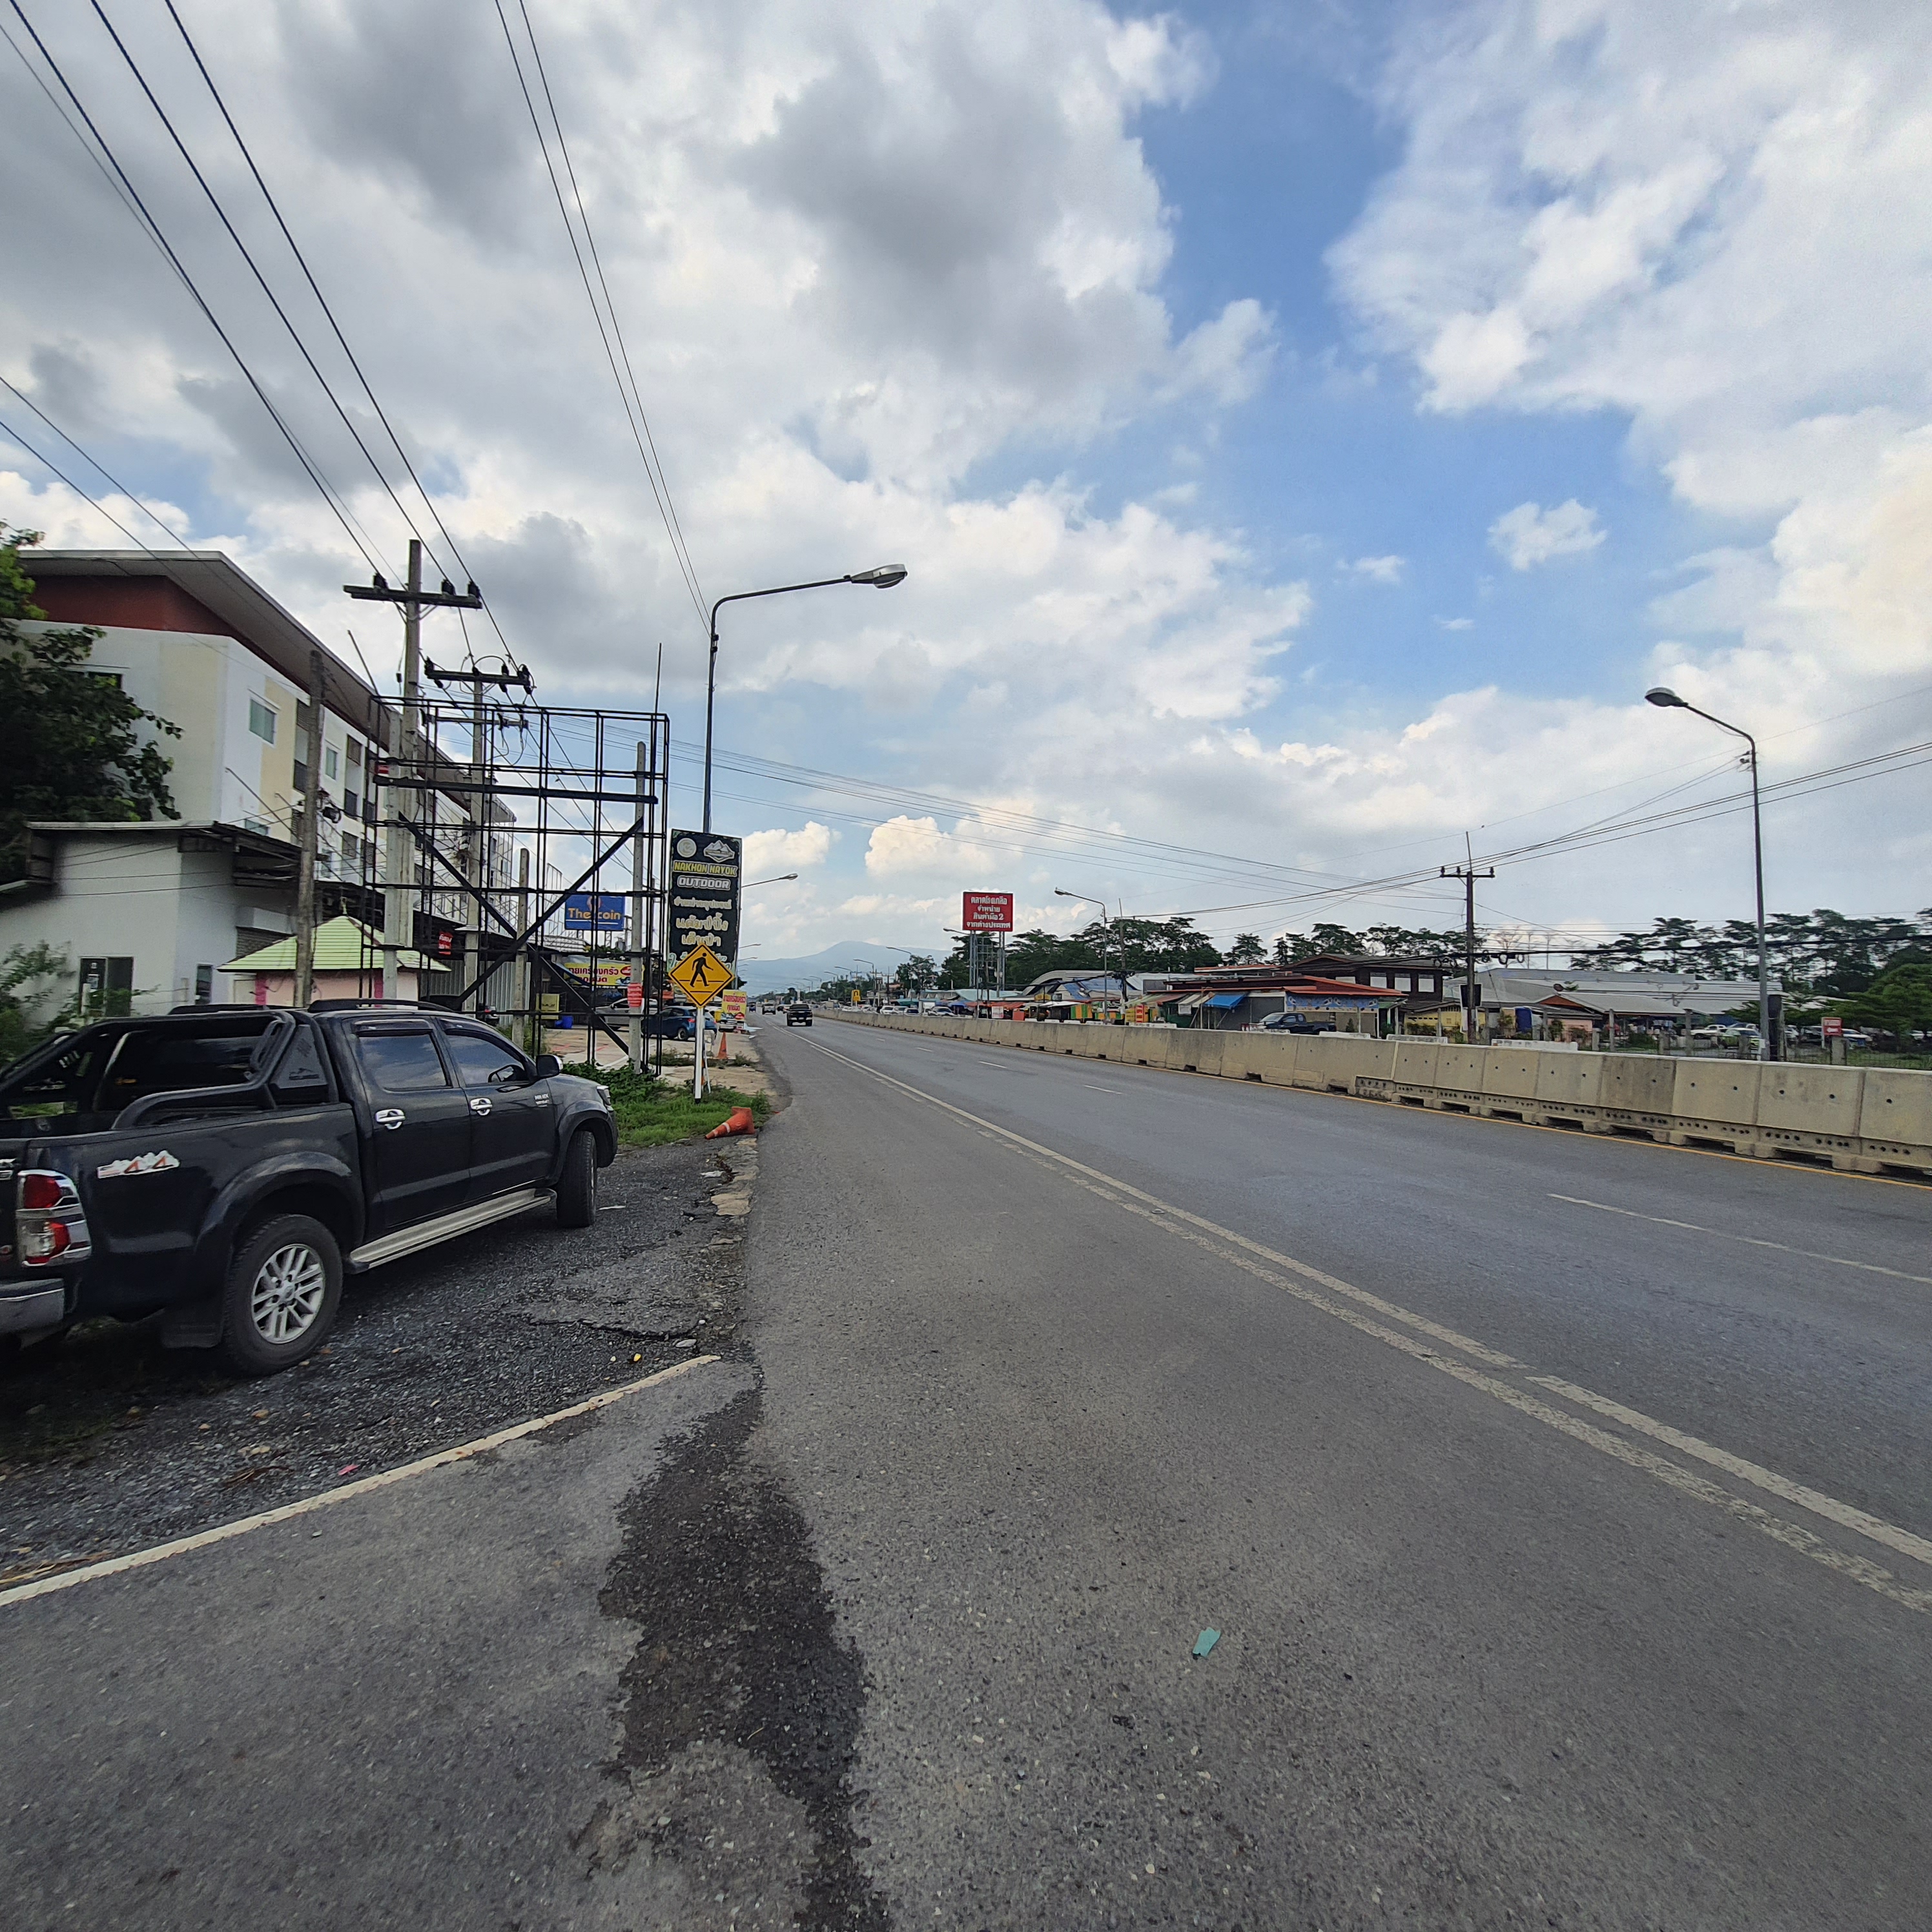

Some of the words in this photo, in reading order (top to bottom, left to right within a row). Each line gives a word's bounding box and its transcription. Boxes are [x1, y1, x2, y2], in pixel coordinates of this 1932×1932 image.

[674, 861, 708, 874] NAKHON
[710, 864, 736, 876] NAYOK
[679, 877, 730, 889] OUTDOOR
[568, 908, 592, 919] The
